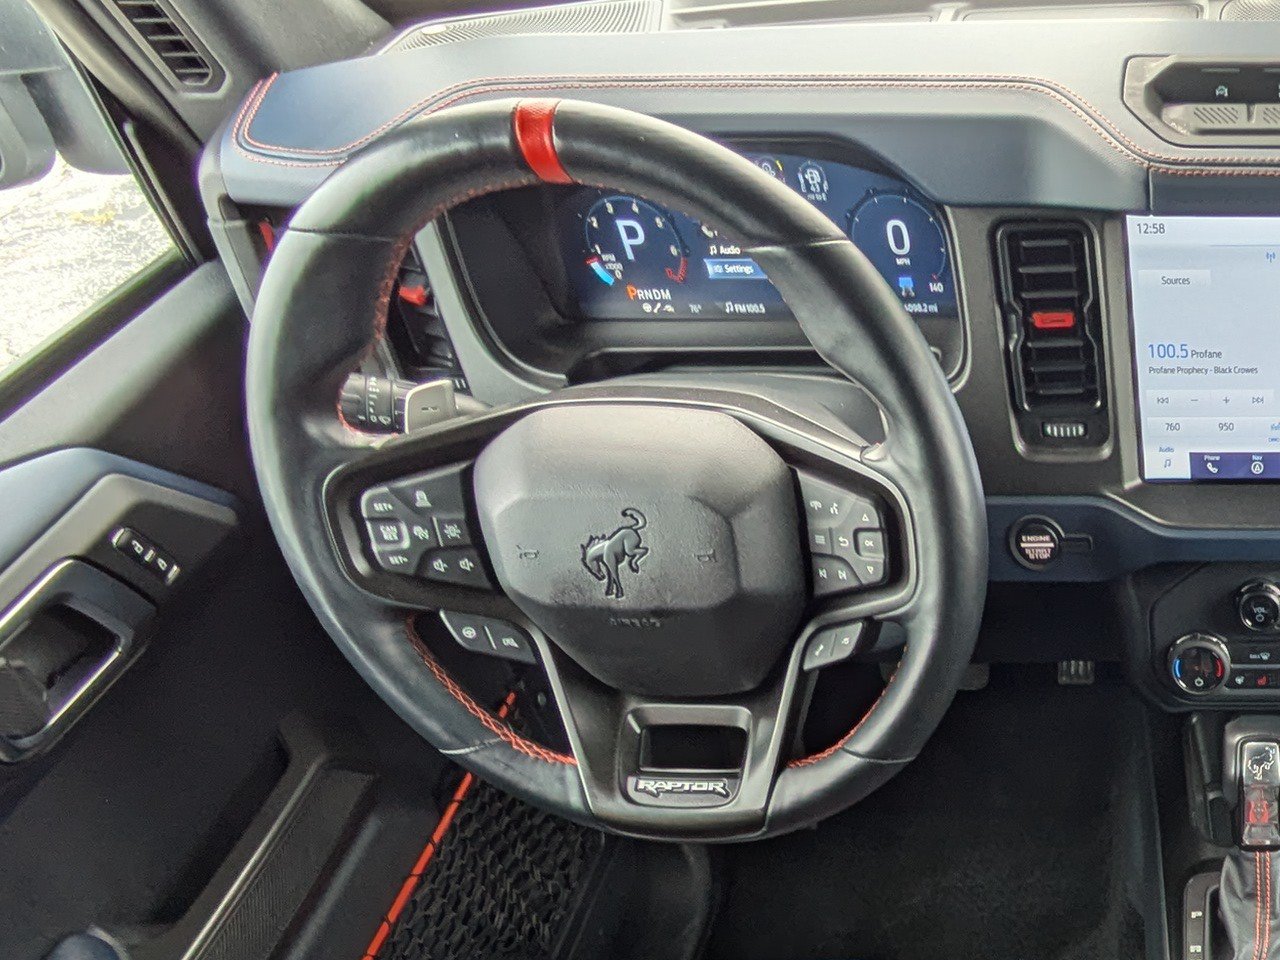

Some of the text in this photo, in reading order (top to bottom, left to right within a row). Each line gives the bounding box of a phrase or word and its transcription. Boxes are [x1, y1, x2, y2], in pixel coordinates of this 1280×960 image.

[1137, 223, 1166, 235] 12:58
[615, 218, 645, 261] P
[886, 219, 911, 255] 0
[719, 245, 741, 255] Audio
[724, 263, 754, 275] Settings
[1161, 276, 1191, 285] Sources
[1148, 343, 1223, 359] 100.5 Profane
[1148, 366, 1175, 374] Profane
[1176, 366, 1208, 375] Prophecy
[1213, 366, 1233, 374] Black
[1233, 366, 1258, 374] Crowes
[1165, 422, 1181, 431] 760
[1218, 422, 1235, 431] 950
[1021, 534, 1052, 542] ENGINE
[636, 778, 732, 797] RAPTOR
